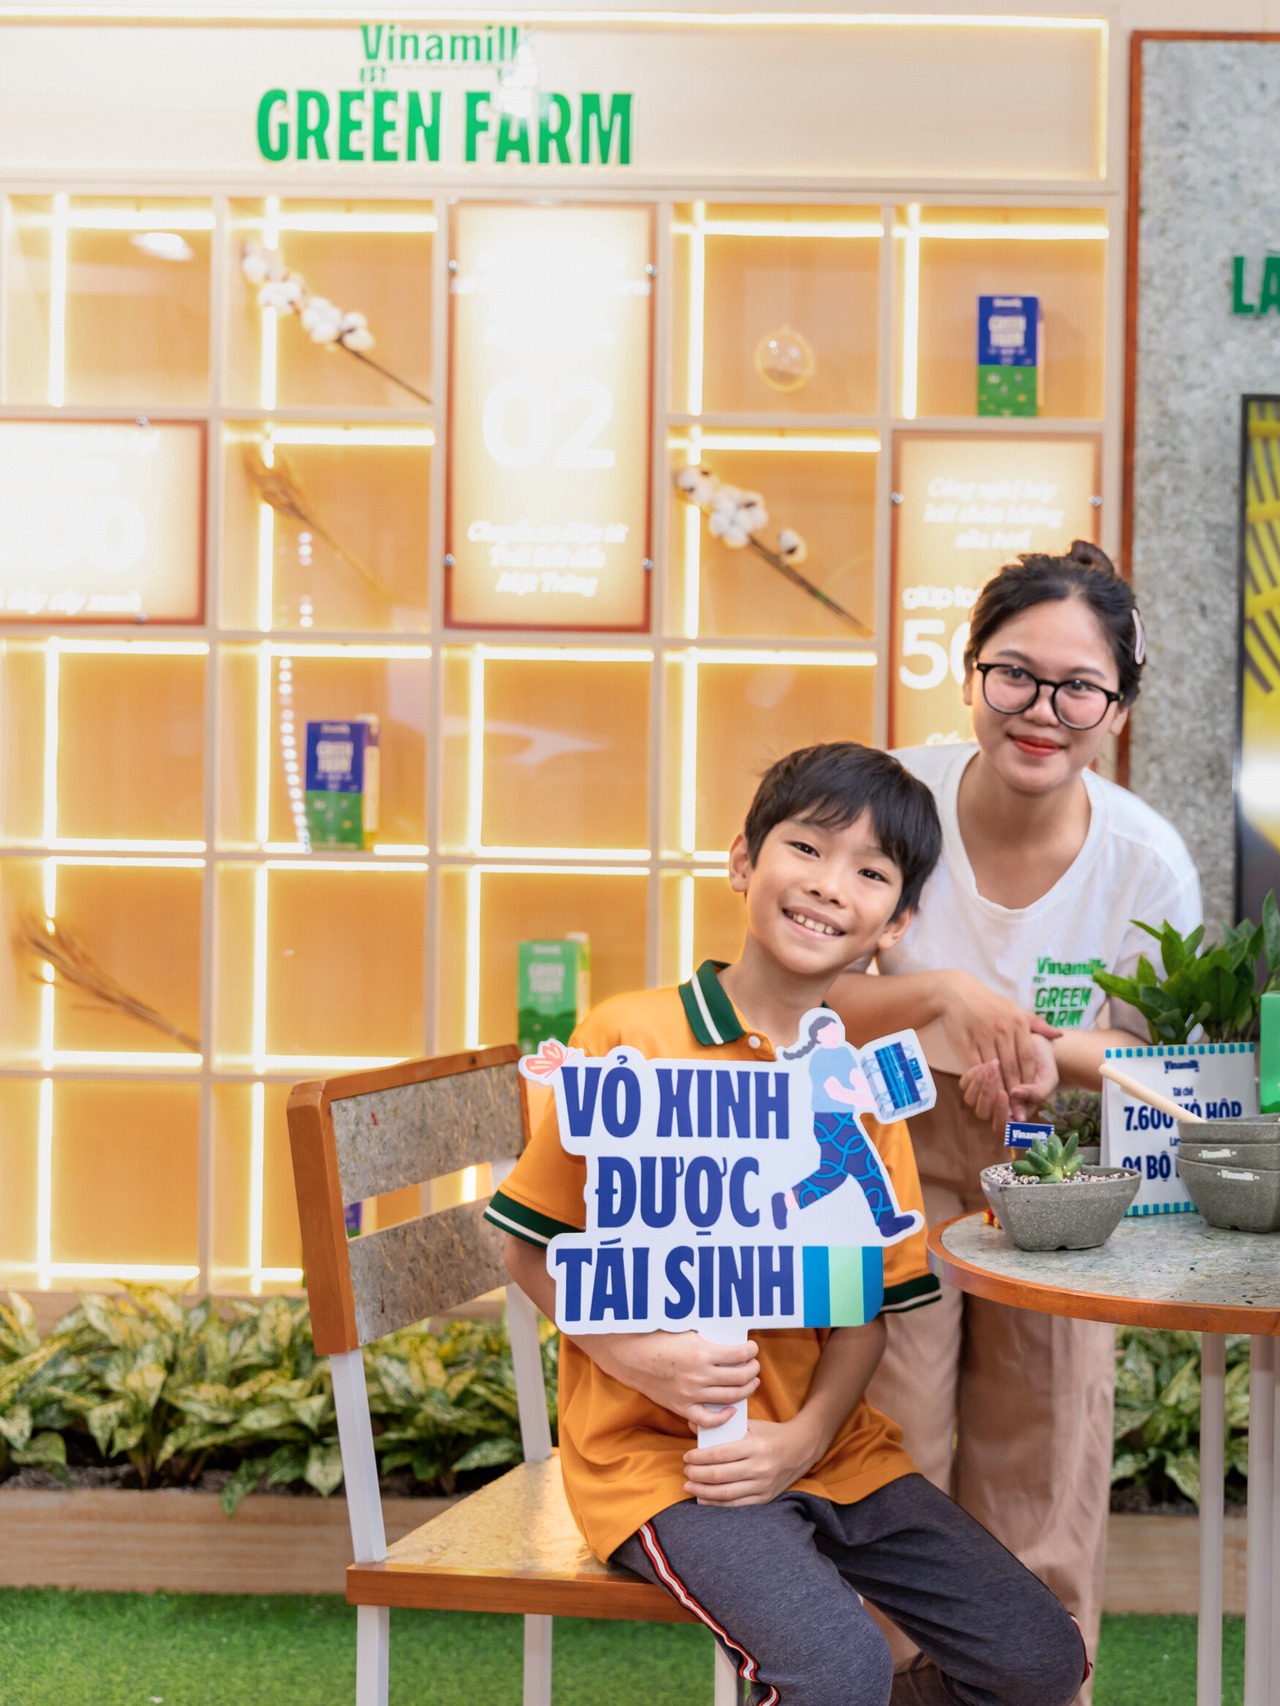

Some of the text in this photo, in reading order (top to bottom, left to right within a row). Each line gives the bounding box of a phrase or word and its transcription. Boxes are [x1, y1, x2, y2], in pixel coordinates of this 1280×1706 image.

[257, 89, 633, 165] GREEN FARM
[483, 378, 615, 469] 02
[1035, 987, 1092, 1008] GREEN
[561, 1055, 790, 1140] VỎ XINH
[595, 1156, 760, 1236] ĐƯỢC
[1146, 1151, 1171, 1182] BỘ
[555, 1237, 795, 1321] TÁI SINH
